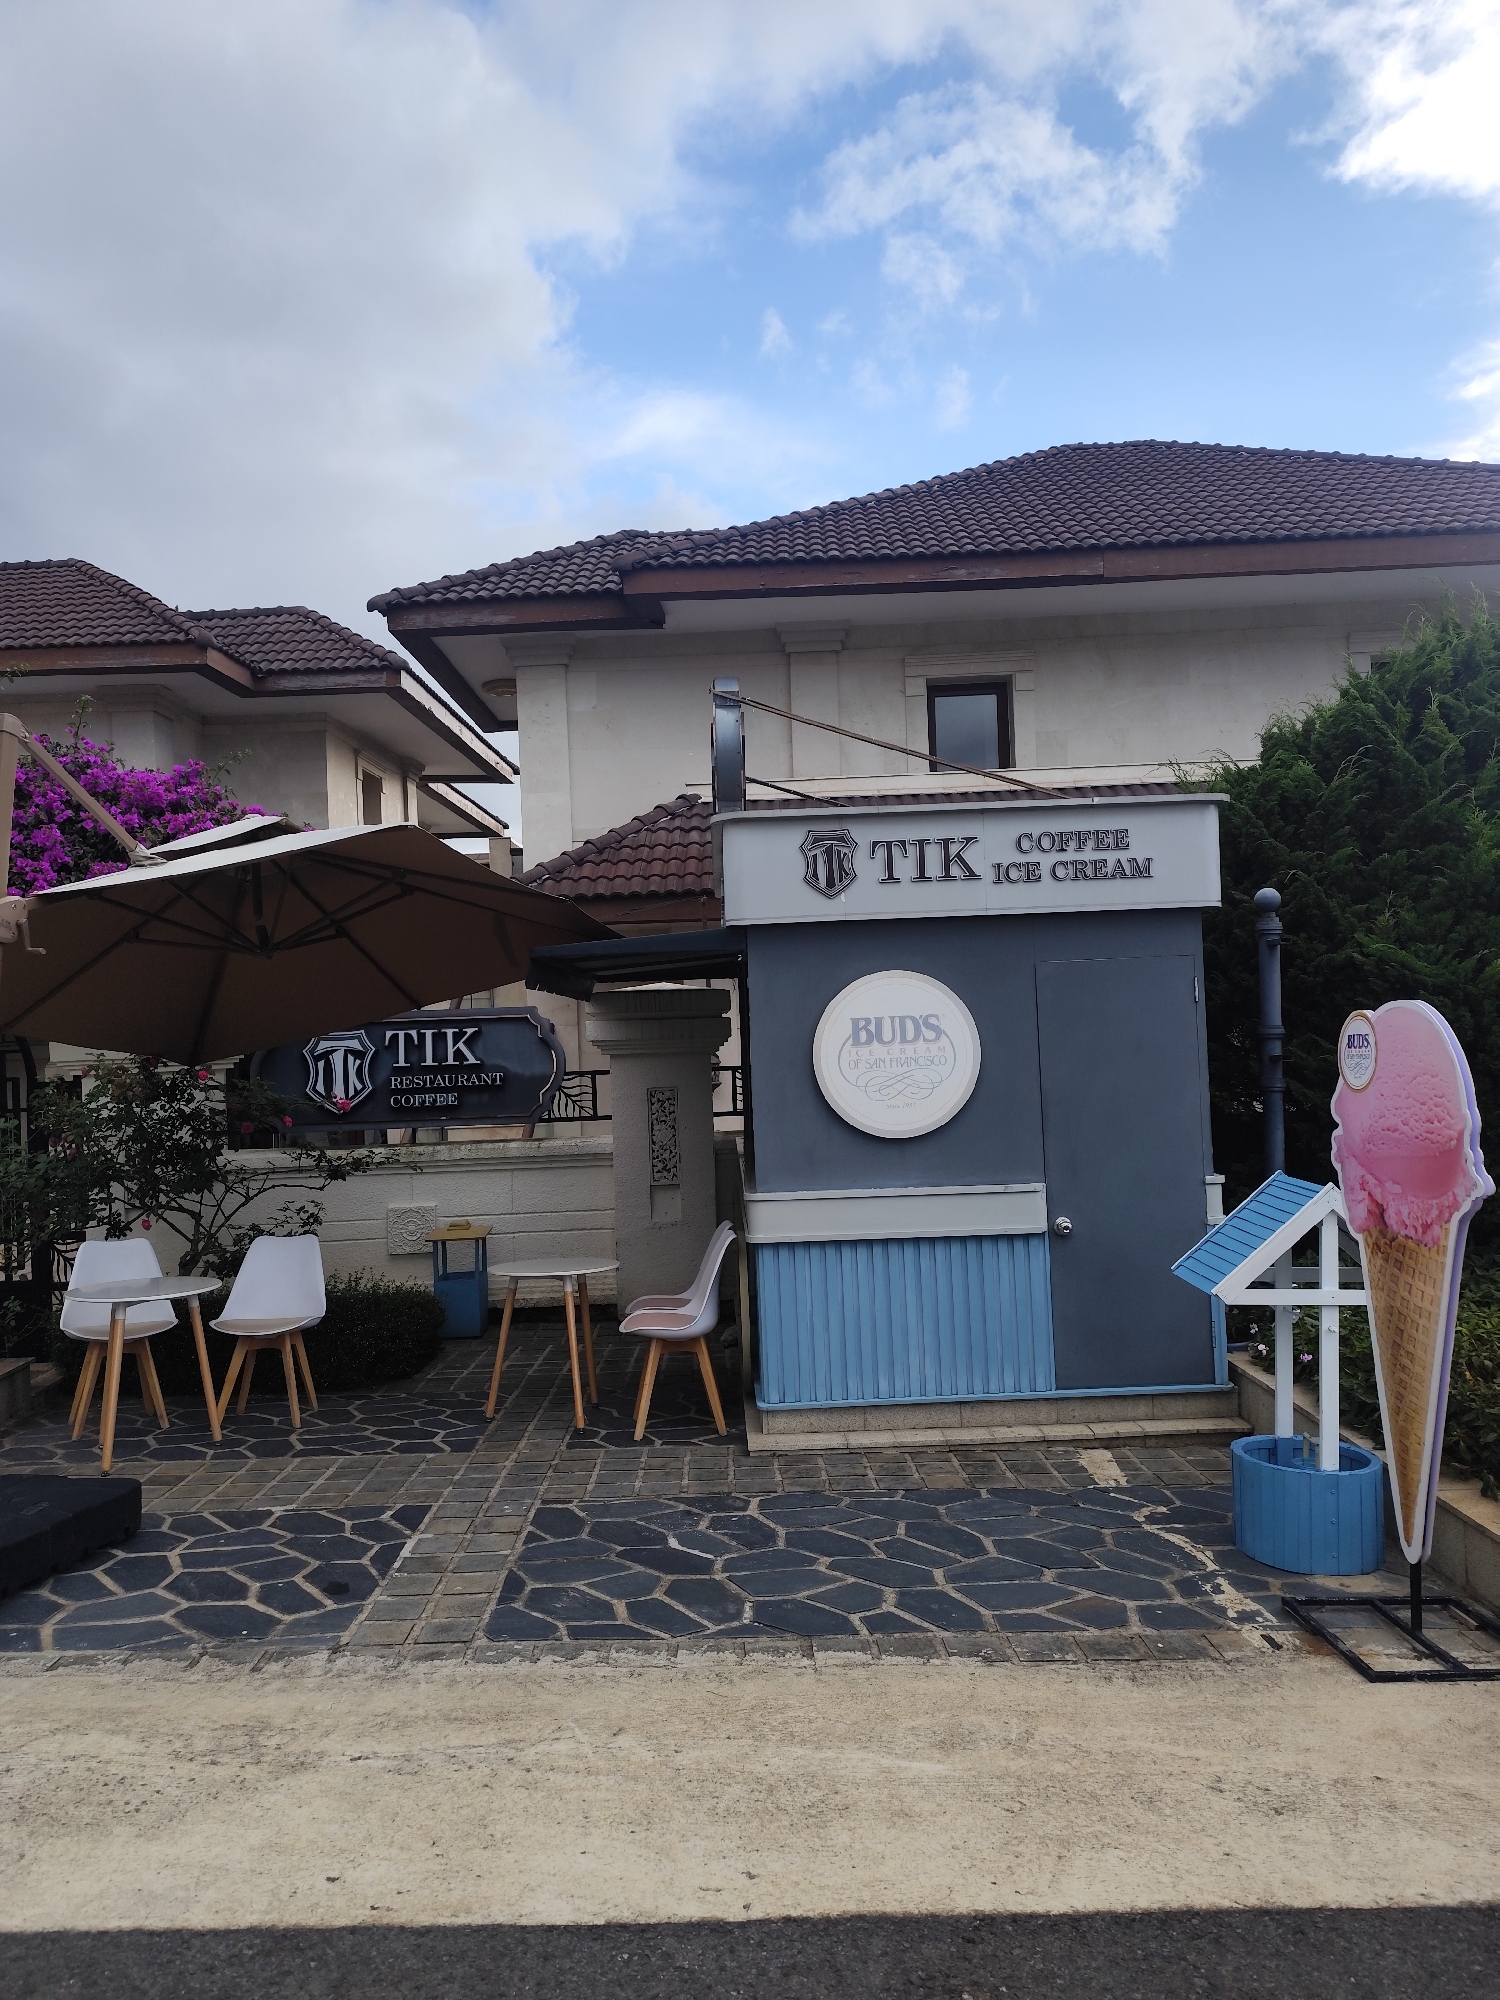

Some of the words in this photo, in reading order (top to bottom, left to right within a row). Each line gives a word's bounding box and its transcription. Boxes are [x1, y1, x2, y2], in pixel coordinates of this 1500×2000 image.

[1016, 829, 1130, 853] COFFEE
[870, 836, 982, 883] TIK
[992, 861, 1042, 883] ICE
[1050, 857, 1154, 880] CREAM
[850, 1014, 943, 1048] BUD'S
[384, 1027, 482, 1068] TIK
[848, 1049, 875, 1058] ICE
[887, 1046, 946, 1056] CREAM
[848, 1059, 863, 1070] OF
[865, 1057, 887, 1070] SAN
[889, 1055, 948, 1068] FRANCISCO
[390, 1073, 504, 1089] RESTAURANT
[390, 1093, 458, 1108] COFFEE
